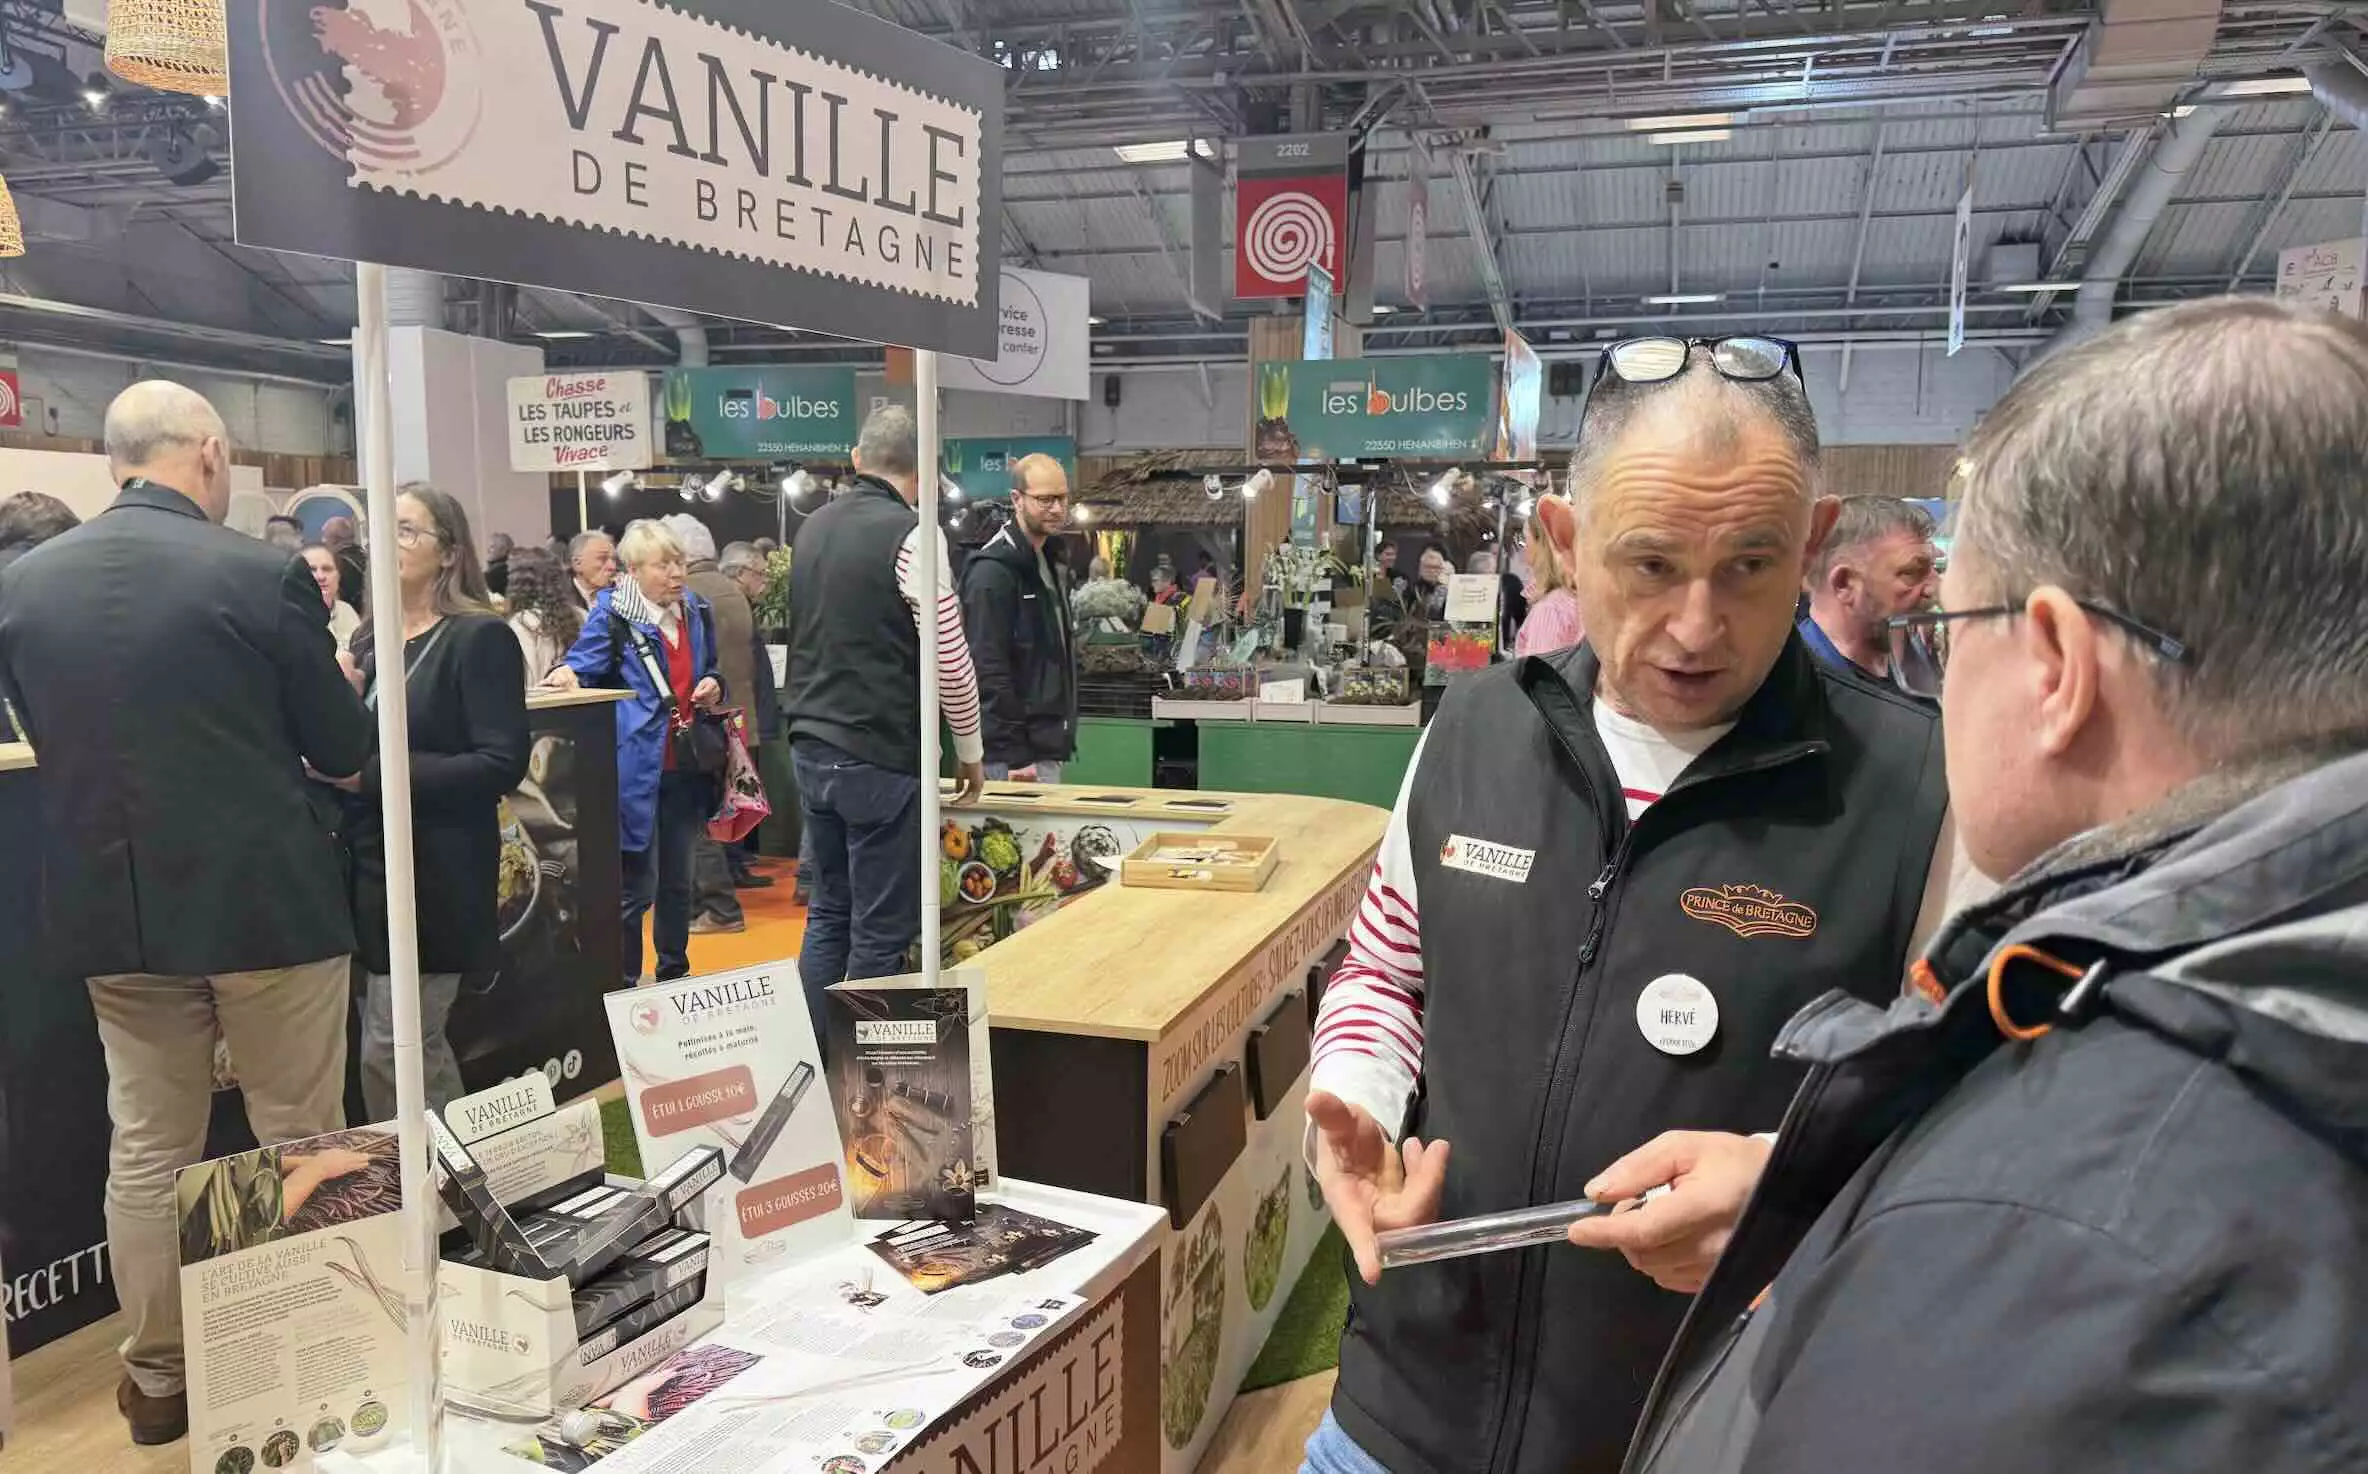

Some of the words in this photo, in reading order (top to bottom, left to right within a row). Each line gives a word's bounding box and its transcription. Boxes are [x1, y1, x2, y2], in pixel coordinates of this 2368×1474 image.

[524, 0, 965, 230] VANILLE
[573, 149, 648, 207] DE
[696, 178, 963, 279] BRETAGNE
[1000, 305, 1028, 320] vice
[1000, 325, 1035, 337] resse
[546, 378, 605, 398] Chasse
[1322, 389, 1358, 415] les
[1366, 379, 1468, 416] bulbes
[519, 404, 546, 421] LES
[552, 401, 615, 420] TAUPES
[719, 395, 749, 418] les
[756, 388, 839, 420] bulbes
[524, 426, 549, 443] LES
[554, 424, 635, 442] RONGEURS
[553, 445, 608, 464] Vivace
[1464, 843, 1532, 870] VANILLE
[1686, 894, 1731, 912] PRINCE
[1732, 903, 1744, 914] de
[1745, 904, 1813, 928] BRETAGNE
[670, 975, 774, 1015] VANILLE
[872, 1023, 934, 1036] VANILLE
[1660, 1008, 1697, 1025] HERVÉ
[465, 1087, 537, 1124] VANILLE
[652, 1099, 676, 1120] ÉTUI
[686, 1086, 723, 1110] GOUSSE
[775, 1185, 816, 1211] GOUSSES
[817, 1178, 840, 1197] 20€
[276, 1239, 328, 1259] VANILLE
[451, 1319, 510, 1346] VANILLE
[620, 1328, 672, 1374] VANILLE
[918, 1324, 1114, 1474] NILLE
